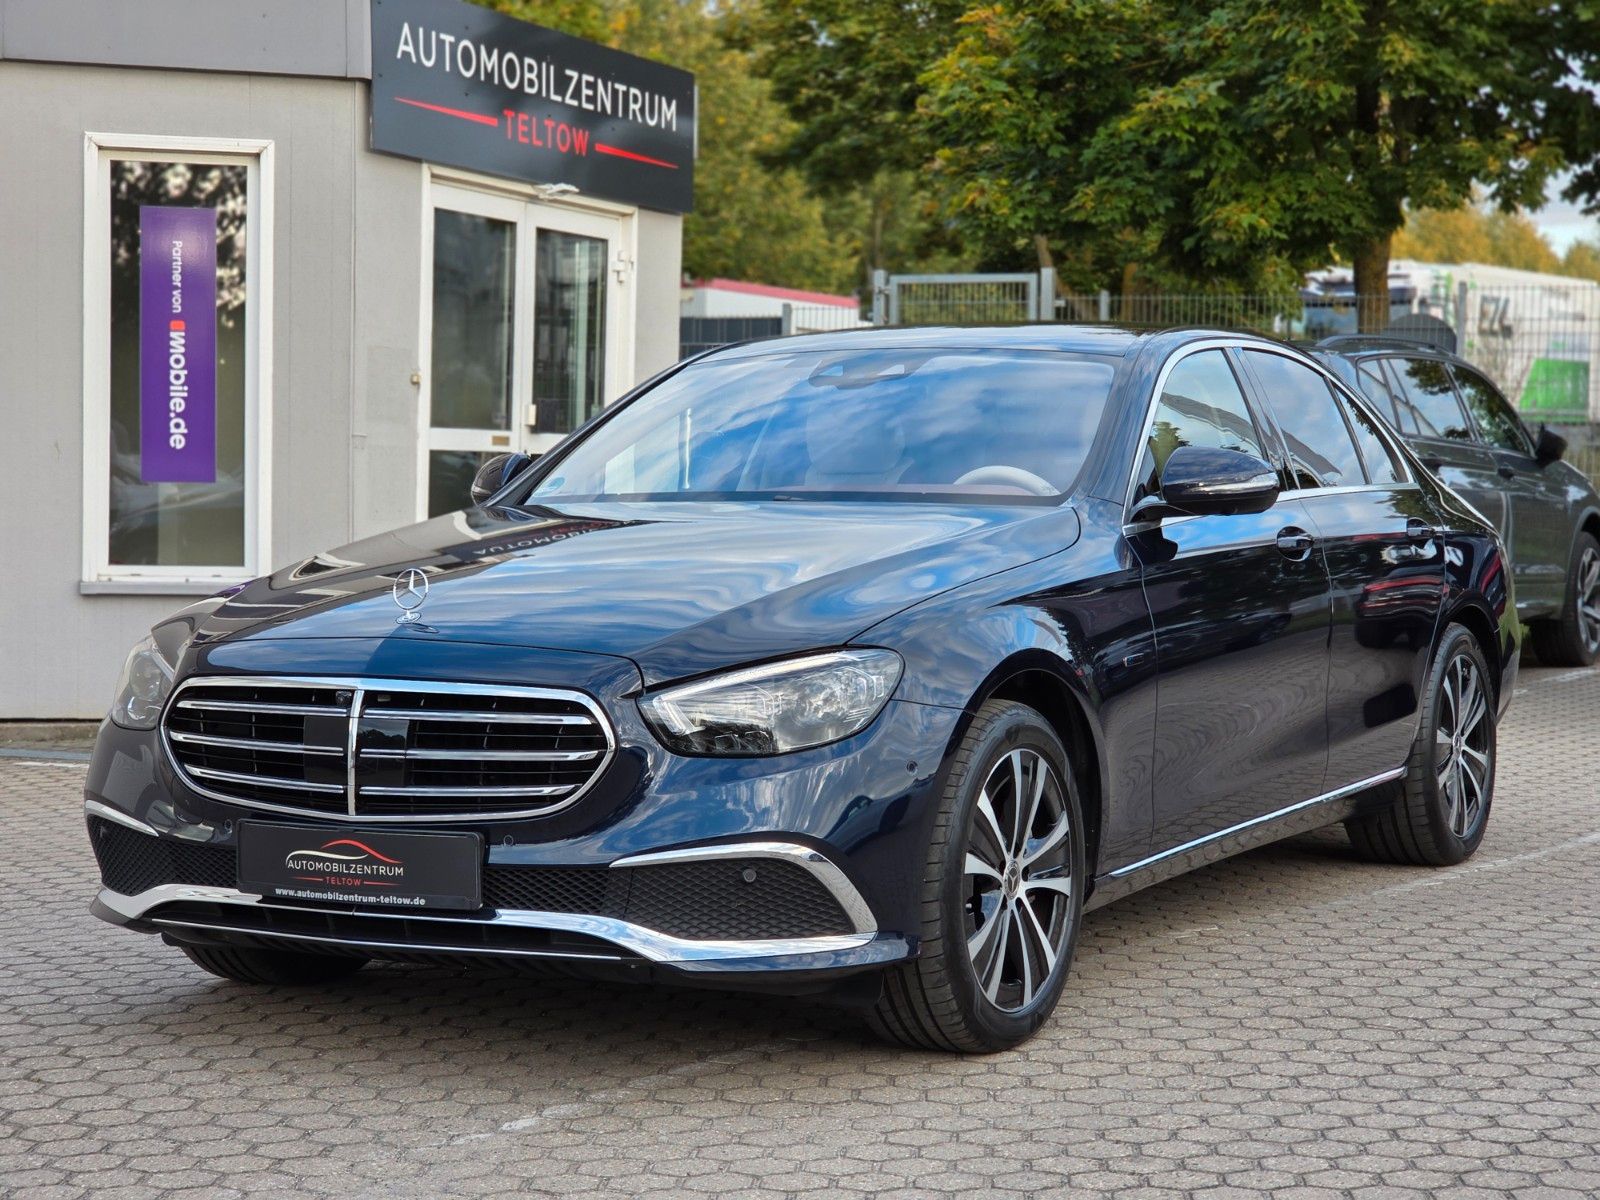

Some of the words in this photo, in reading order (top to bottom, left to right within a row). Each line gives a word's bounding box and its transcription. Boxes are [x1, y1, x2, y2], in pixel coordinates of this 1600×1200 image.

[397, 22, 677, 131] AUTOMOBILZENTRUM
[503, 108, 589, 157] TELTOW
[172, 240, 183, 287] Partner
[171, 289, 183, 313] von
[169, 331, 188, 450] mobile.de
[287, 860, 404, 876] AUTOMOBILZENTRUM
[326, 877, 361, 886] TELTOW
[275, 888, 426, 905] www.automobilzentrum-teltow.de
